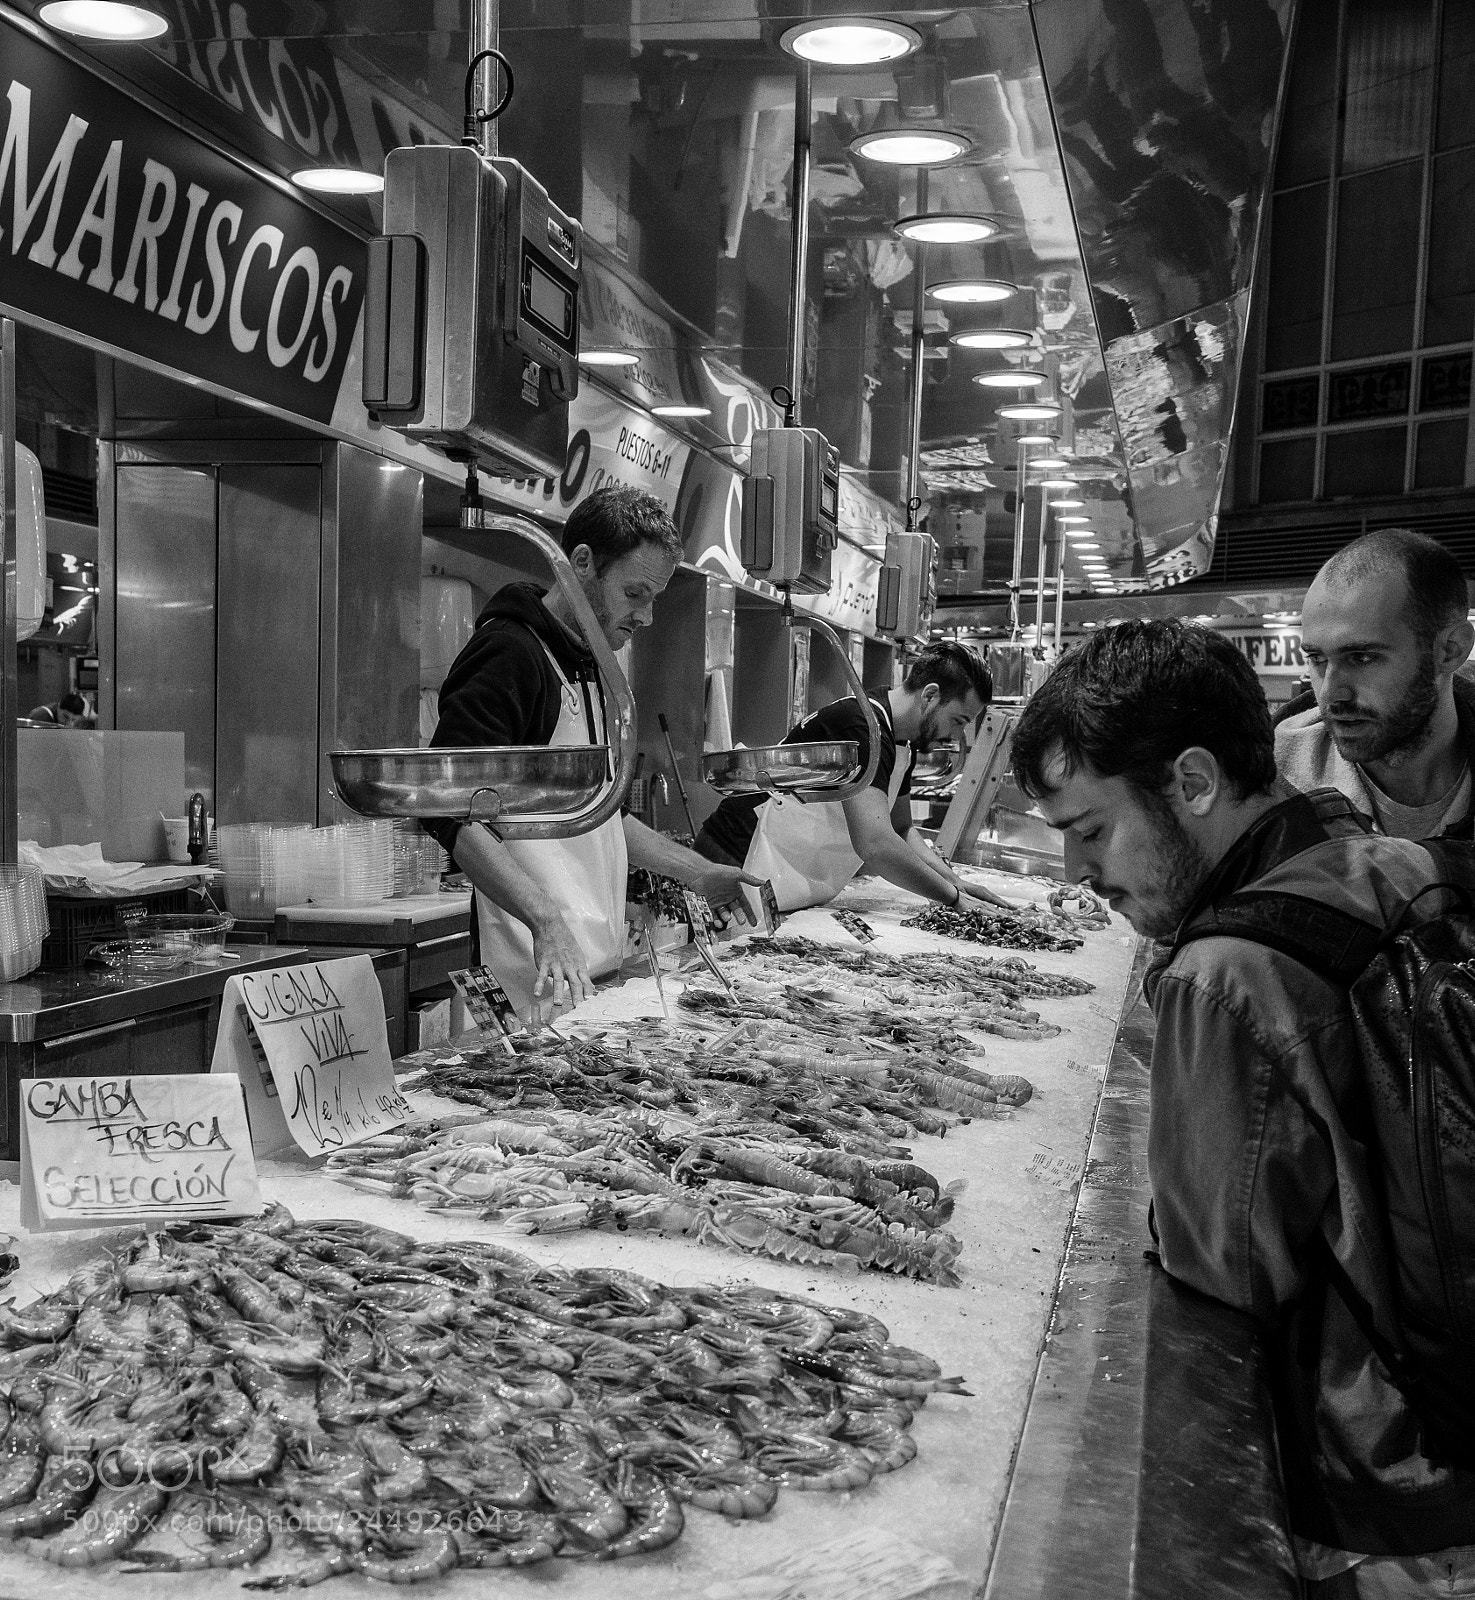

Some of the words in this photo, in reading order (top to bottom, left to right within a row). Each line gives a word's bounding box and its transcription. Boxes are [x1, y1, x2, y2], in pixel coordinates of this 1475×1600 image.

[0, 79, 353, 383] MARISCOS
[615, 426, 655, 470] PUESTOS
[652, 449, 672, 480] 6-11
[28, 1079, 148, 1131] GAMBA
[87, 1116, 233, 1163] FRESCA
